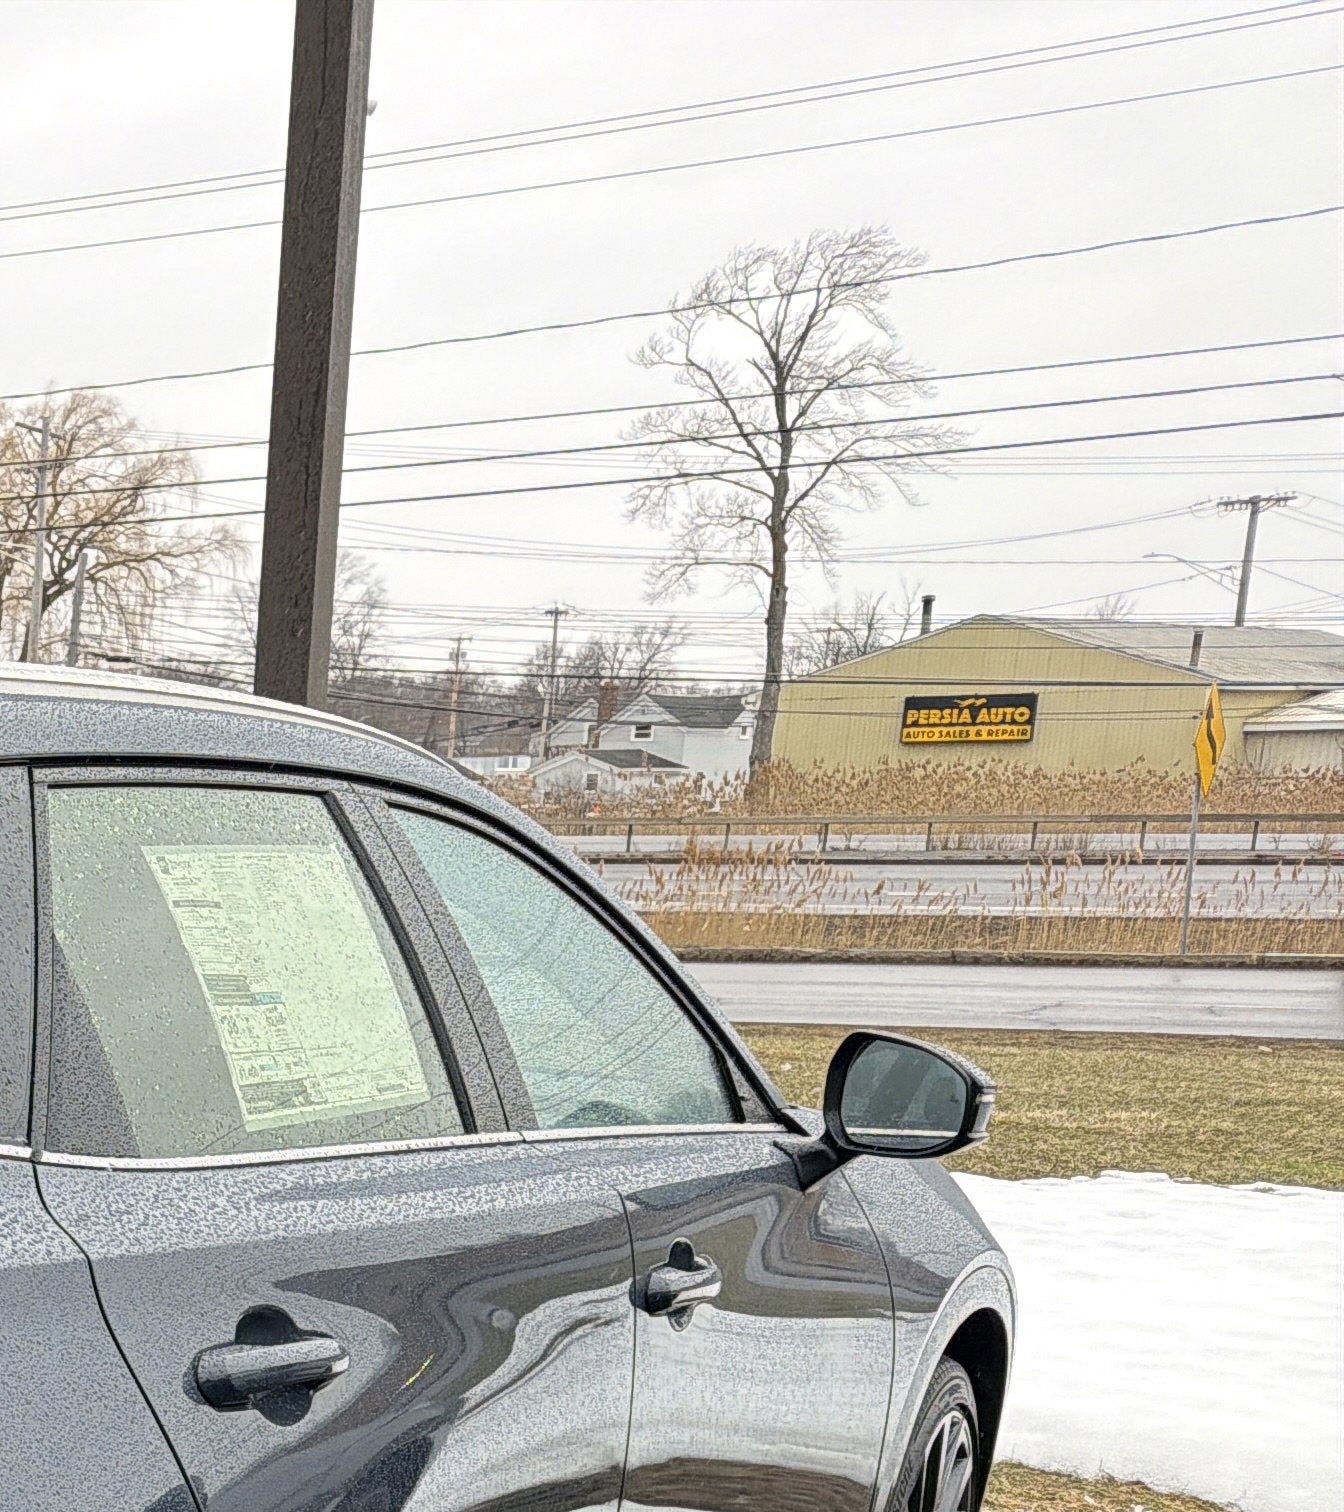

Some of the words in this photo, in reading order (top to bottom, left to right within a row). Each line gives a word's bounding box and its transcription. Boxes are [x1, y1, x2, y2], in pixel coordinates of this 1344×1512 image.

[906, 708, 973, 725] PERSIA
[975, 706, 1031, 724] AUTO
[904, 730, 936, 740] AUTO
[937, 729, 970, 739] SALES
[974, 728, 984, 738] &
[986, 727, 1029, 738] REPAIR
